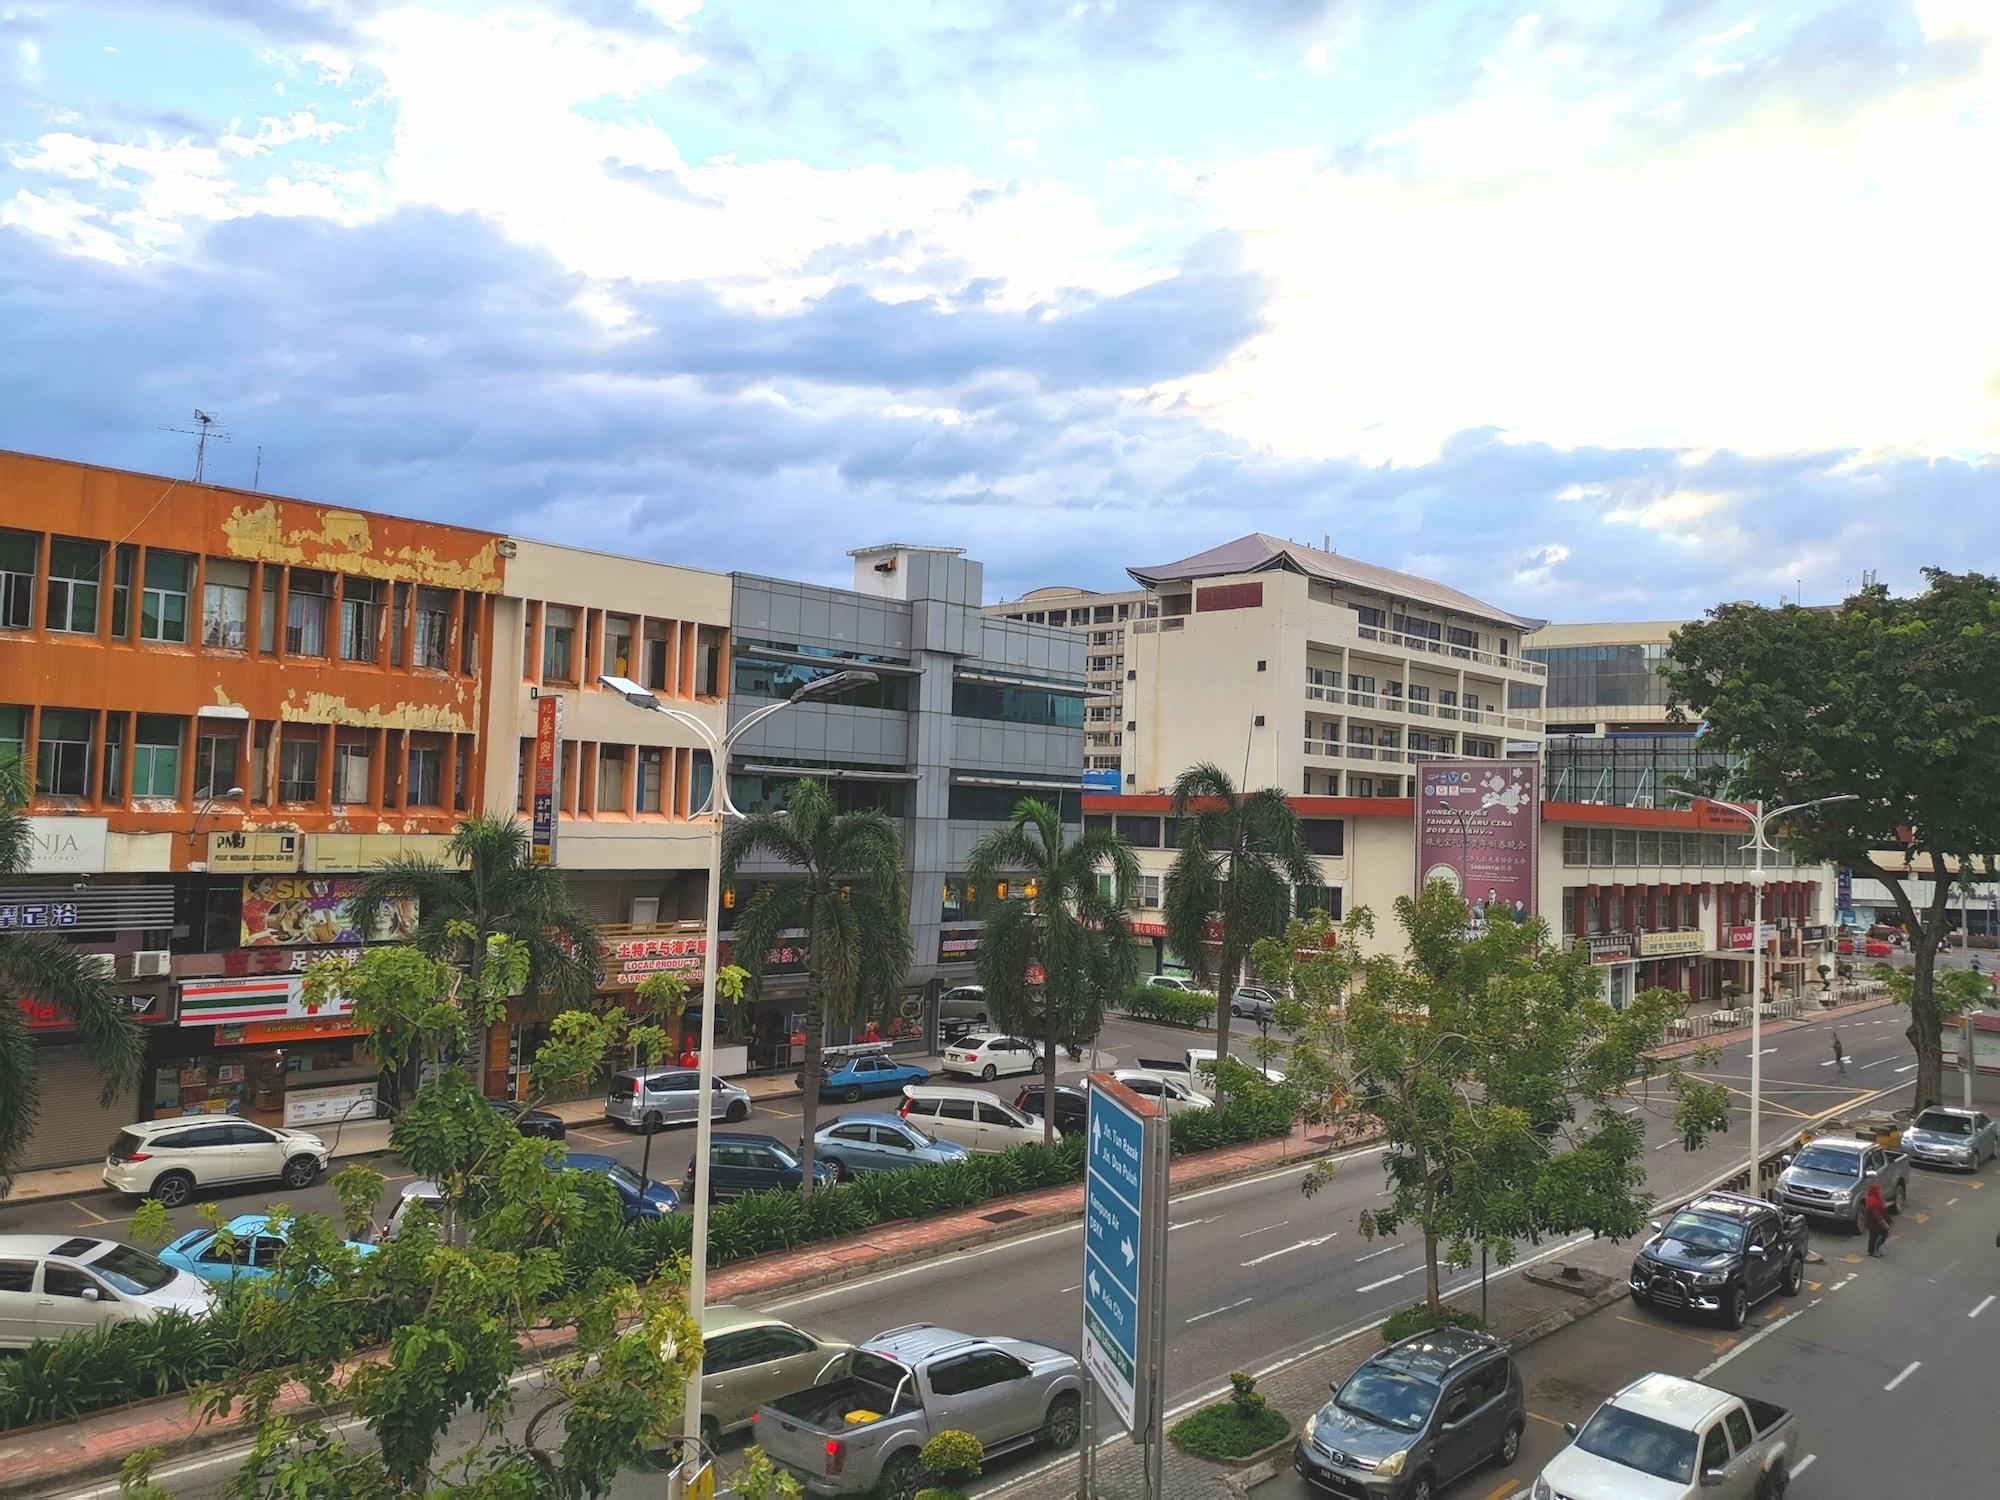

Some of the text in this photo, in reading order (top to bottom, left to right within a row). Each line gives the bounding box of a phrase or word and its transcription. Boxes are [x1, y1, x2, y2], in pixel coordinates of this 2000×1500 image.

[31, 834, 78, 856] NJA
[618, 974, 628, 984] &
[627, 959, 699, 970] LOCAL PRODUCTS
[1112, 1129, 1122, 1149] Tun
[1123, 1138, 1138, 1162] Razak
[1112, 1153, 1122, 1175] Dua
[1122, 1163, 1138, 1188] Puluh
[1090, 1191, 1120, 1230] Kampung Air
[1090, 1215, 1104, 1240] DBKK
[1102, 1288, 1124, 1326] Asia City
